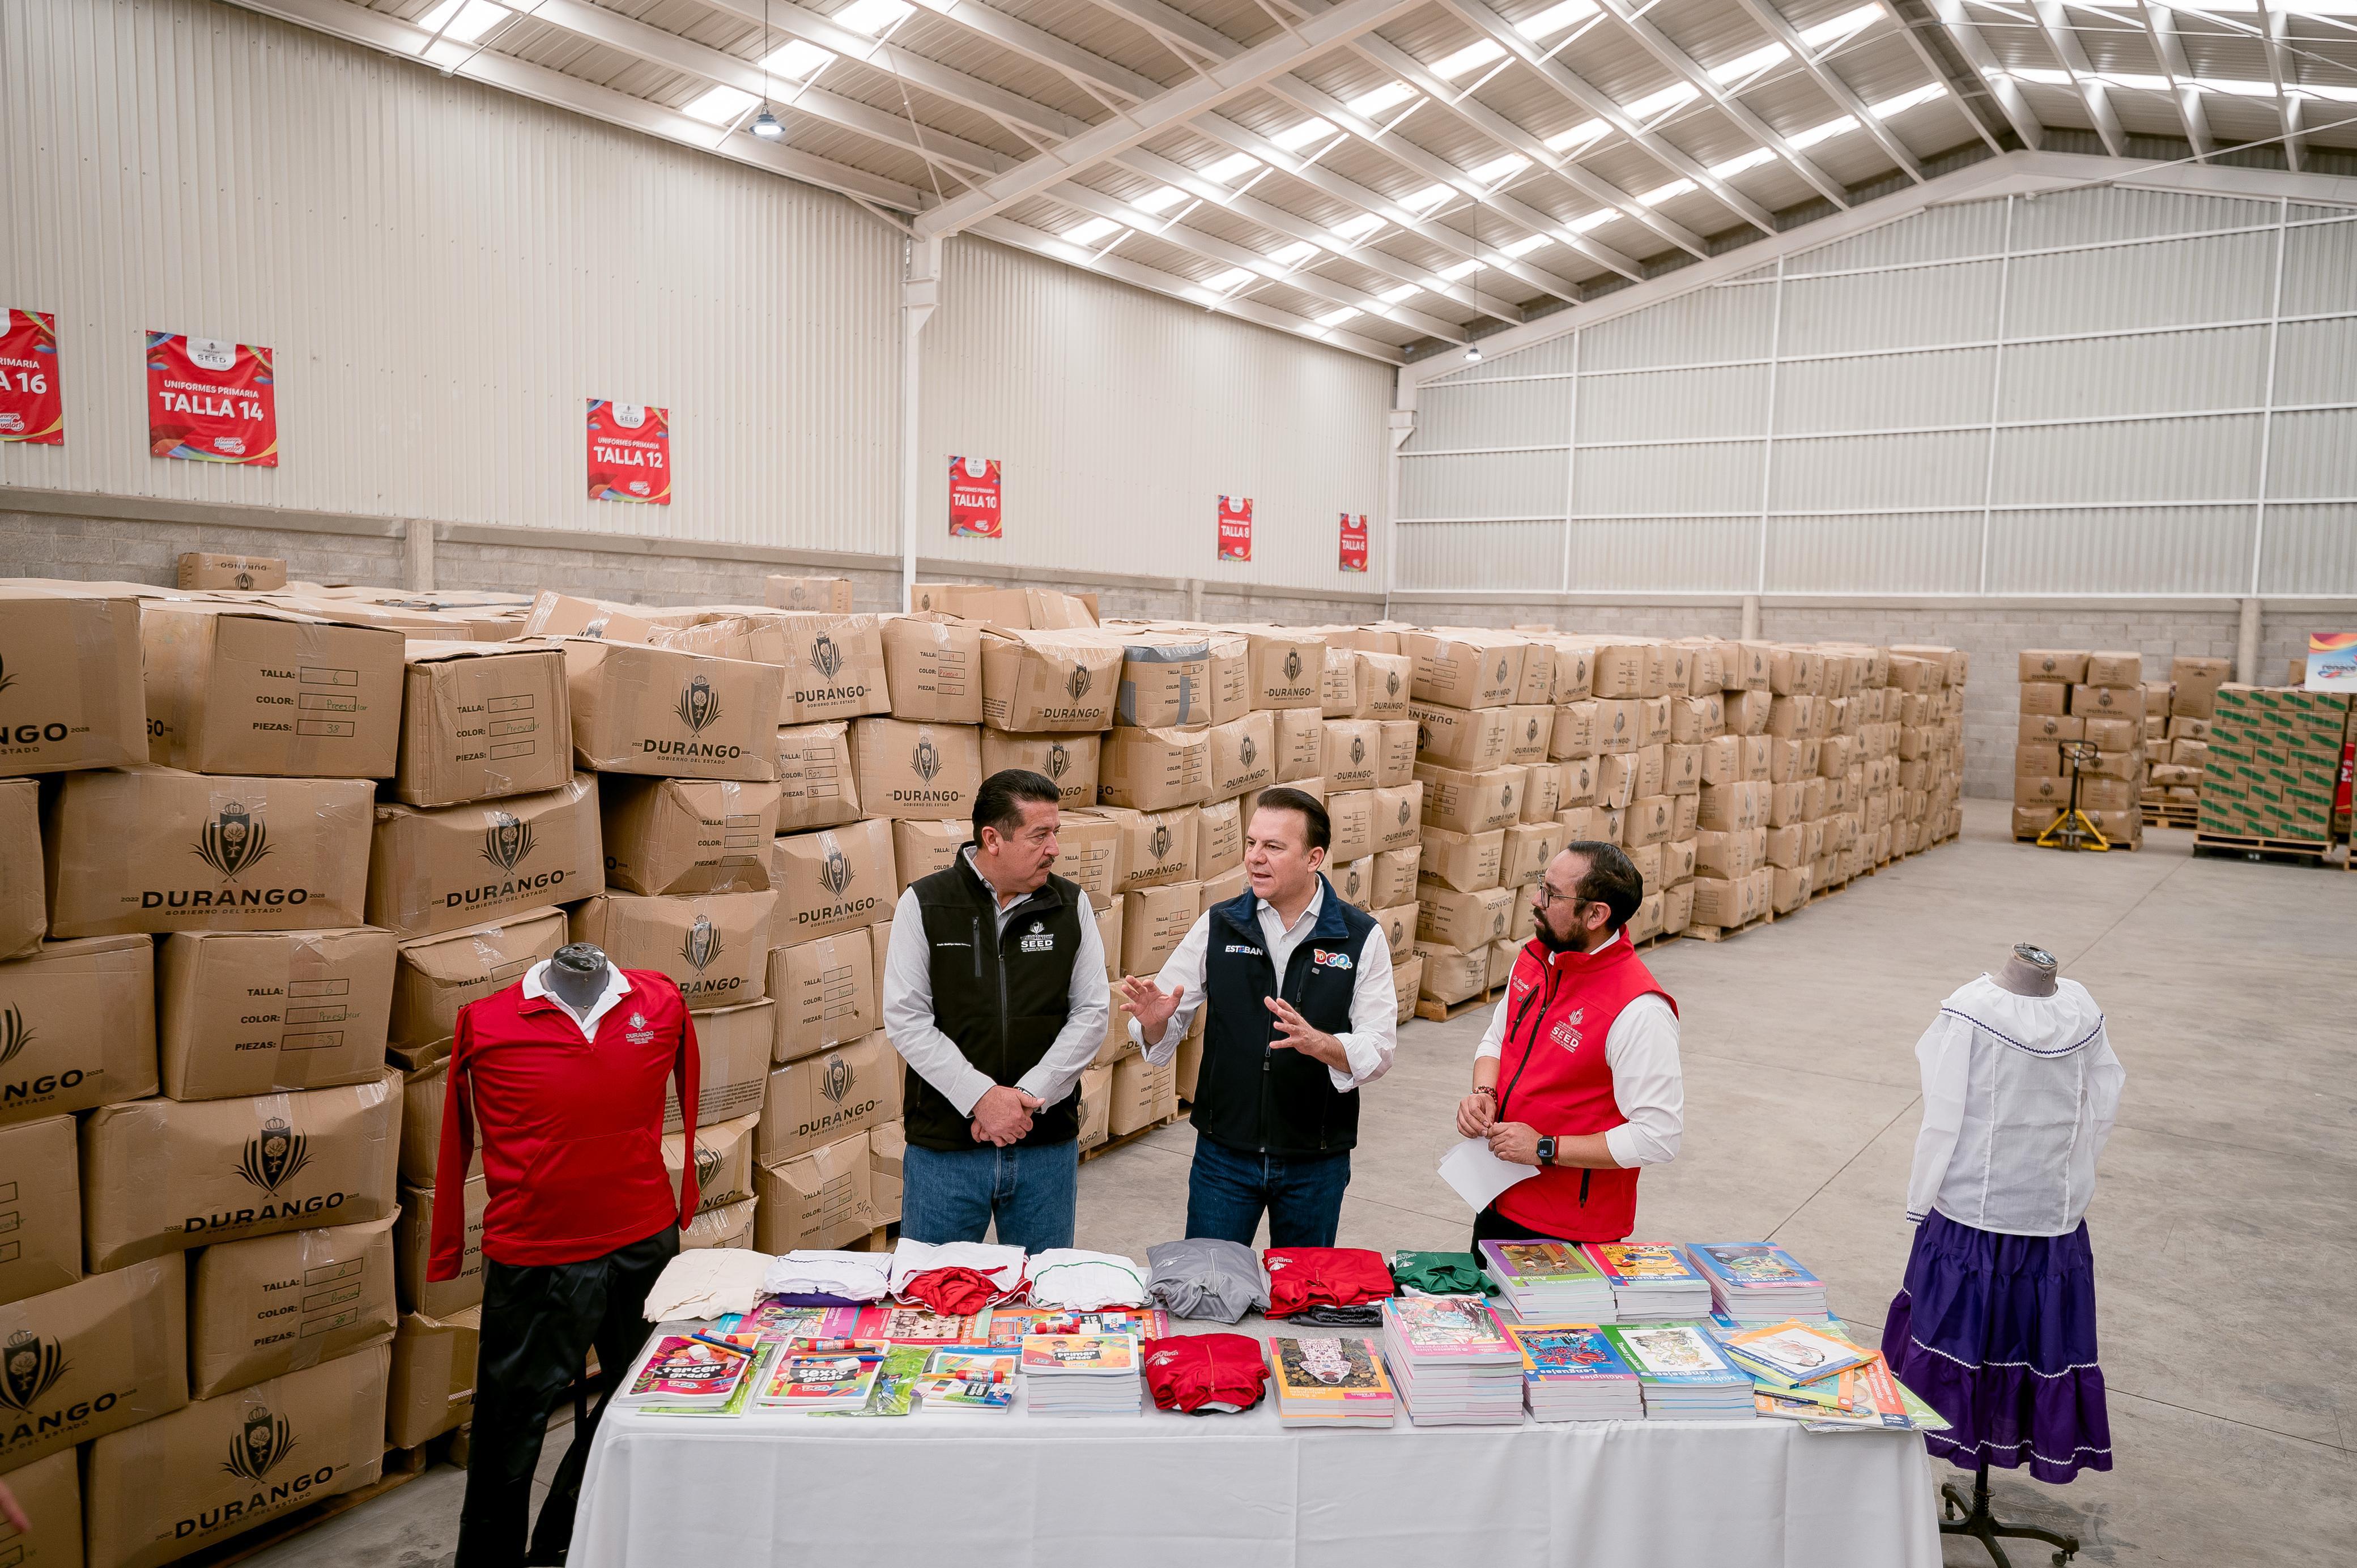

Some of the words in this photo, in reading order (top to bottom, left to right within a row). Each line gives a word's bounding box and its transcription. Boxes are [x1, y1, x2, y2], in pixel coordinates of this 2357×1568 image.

[198, 355, 226, 363] SEED
[16, 373, 47, 394] 16
[164, 380, 216, 393] UNIFORMES
[218, 387, 259, 398] PRIMARIA
[159, 391, 235, 417] TALLA
[239, 401, 264, 421] 14
[598, 436, 632, 446] UNIFORMES
[594, 446, 644, 466] TALLA
[647, 452, 662, 468] 12
[953, 493, 984, 508] TALLA
[986, 496, 996, 508] 10
[1221, 525, 1243, 538] TALLA
[1244, 527, 1249, 538] 8
[1342, 540, 1360, 550] TALLA
[1360, 541, 1364, 551] 6
[220, 563, 266, 571] DURANGO
[260, 670, 295, 679] TALLA:
[795, 685, 865, 703] DURANGO
[1269, 687, 1311, 697] DURANGO
[1486, 689, 1511, 699] DURANGO
[256, 696, 294, 706] COLOR:
[1373, 702, 1403, 710] DURANGO
[457, 705, 484, 714] TALLA:
[1044, 708, 1100, 719] DURANGO
[253, 722, 292, 732] PIEZAS:
[327, 724, 341, 734] 38
[456, 727, 486, 738] COLOR:
[643, 739, 741, 759] DURANGO
[1515, 747, 1540, 756] DURANGO
[456, 752, 487, 762] PIEZAS:
[1227, 769, 1266, 791] DURANGO
[1337, 769, 1371, 779] DURANGO
[894, 790, 959, 802] DURANGO
[1488, 813, 1515, 824] DURANGO
[1385, 829, 1414, 842] DURANGO
[1131, 863, 1183, 880] DURANGO
[446, 870, 565, 909] DURANGO
[141, 889, 308, 908] DURANGO
[465, 902, 503, 911] GOBIERNO
[520, 888, 548, 900] ESTADO
[798, 897, 875, 925] DURANGO
[1225, 945, 1263, 955] ESTEBAN
[1518, 978, 1529, 990] Ricardo
[247, 988, 283, 997] TALLA:
[803, 996, 823, 1005] COLOR:
[240, 1014, 280, 1024] COLOR:
[802, 1015, 823, 1024] PIEZAS:
[1552, 1026, 1579, 1047] SEED
[235, 1041, 276, 1051] PIEZAS:
[798, 1100, 875, 1136] DURANGO
[810, 1125, 835, 1139] GOBIERNO
[846, 1115, 864, 1125] ESTADO
[803, 1190, 822, 1201] TALLA:
[184, 1192, 345, 1234] DURANGO
[802, 1208, 822, 1220] COLOR:
[800, 1226, 820, 1238] PIEZAS:
[262, 1279, 300, 1293] TALLA:
[257, 1305, 297, 1320] COLOR:
[253, 1330, 296, 1347] PIEZAS:
[662, 1365, 721, 1374] tercer
[1777, 1367, 1793, 1377] Libro
[175, 1465, 333, 1540] DURANGO
[277, 1491, 312, 1507] ESTADO
